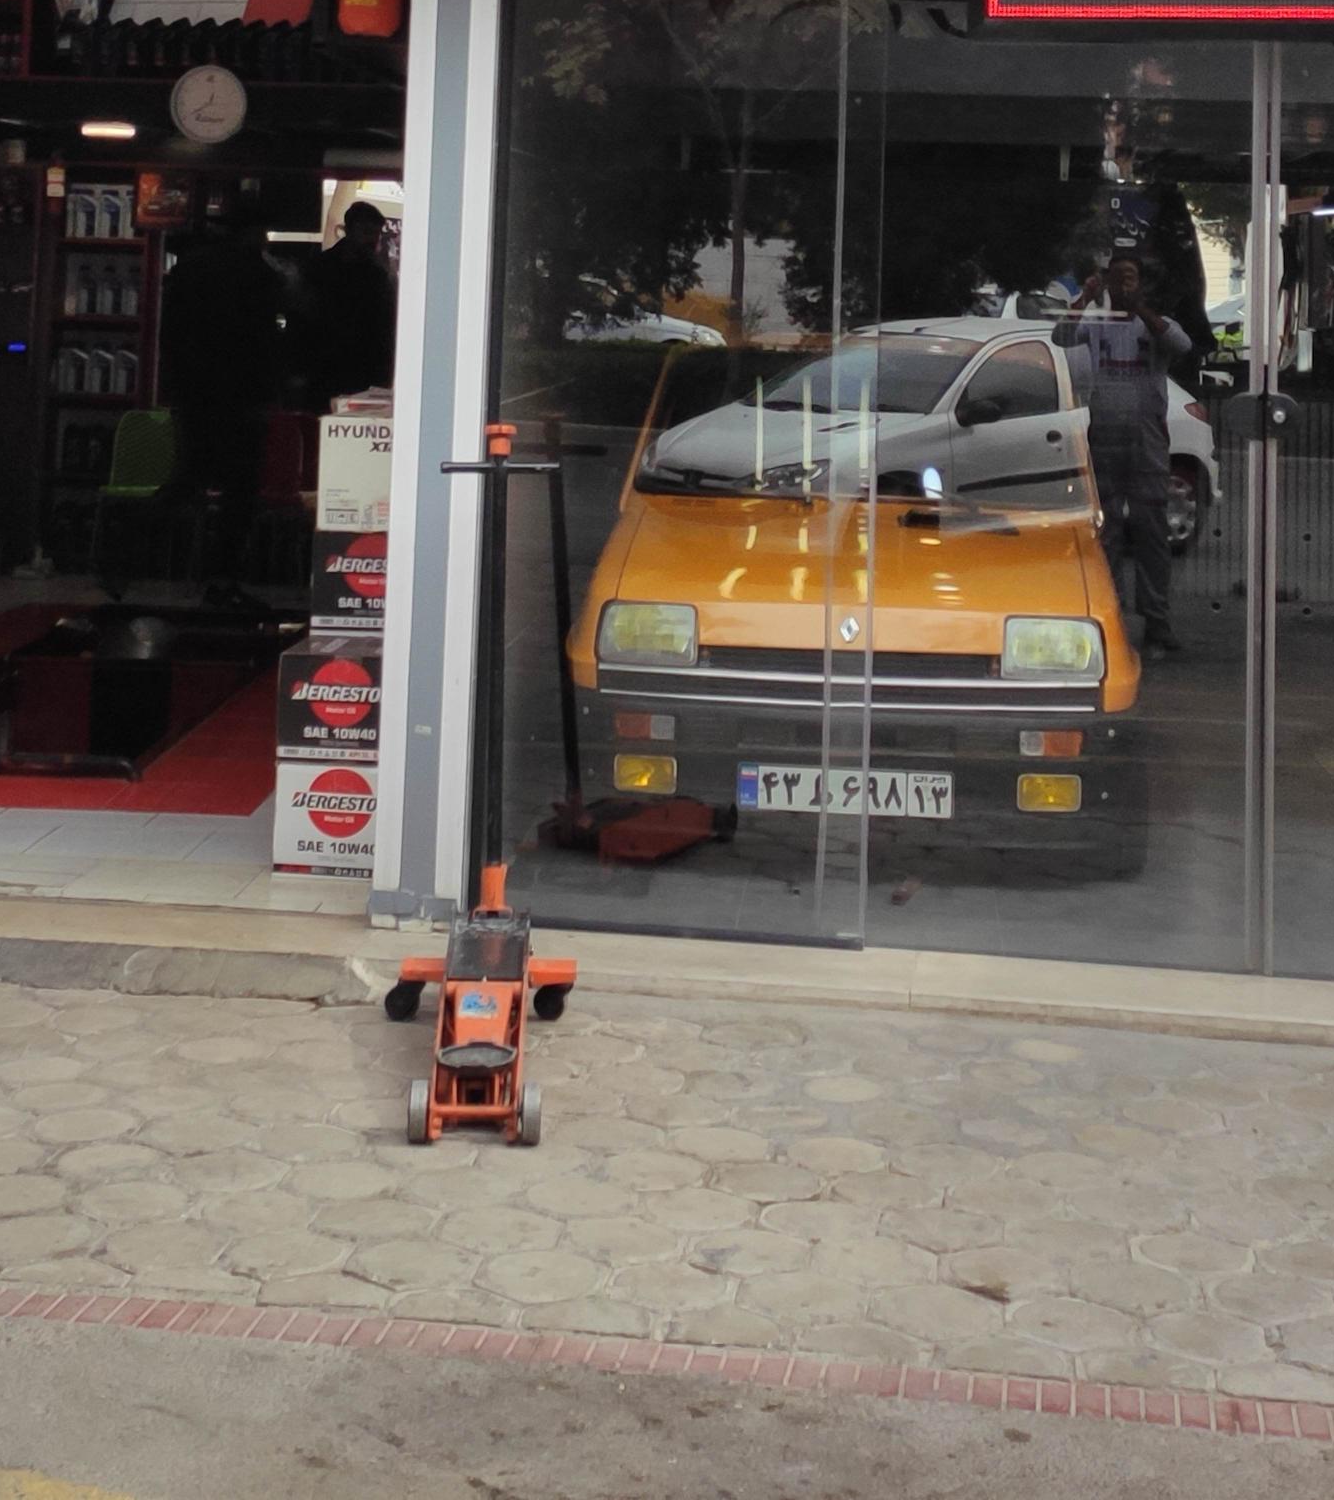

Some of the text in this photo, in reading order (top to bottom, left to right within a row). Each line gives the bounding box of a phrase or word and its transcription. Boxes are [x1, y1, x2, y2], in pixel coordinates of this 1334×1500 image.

[327, 425, 392, 439] HYUND
[370, 441, 392, 453] XT
[303, 726, 377, 741] SAE 10W40
[297, 840, 324, 853] SAE
